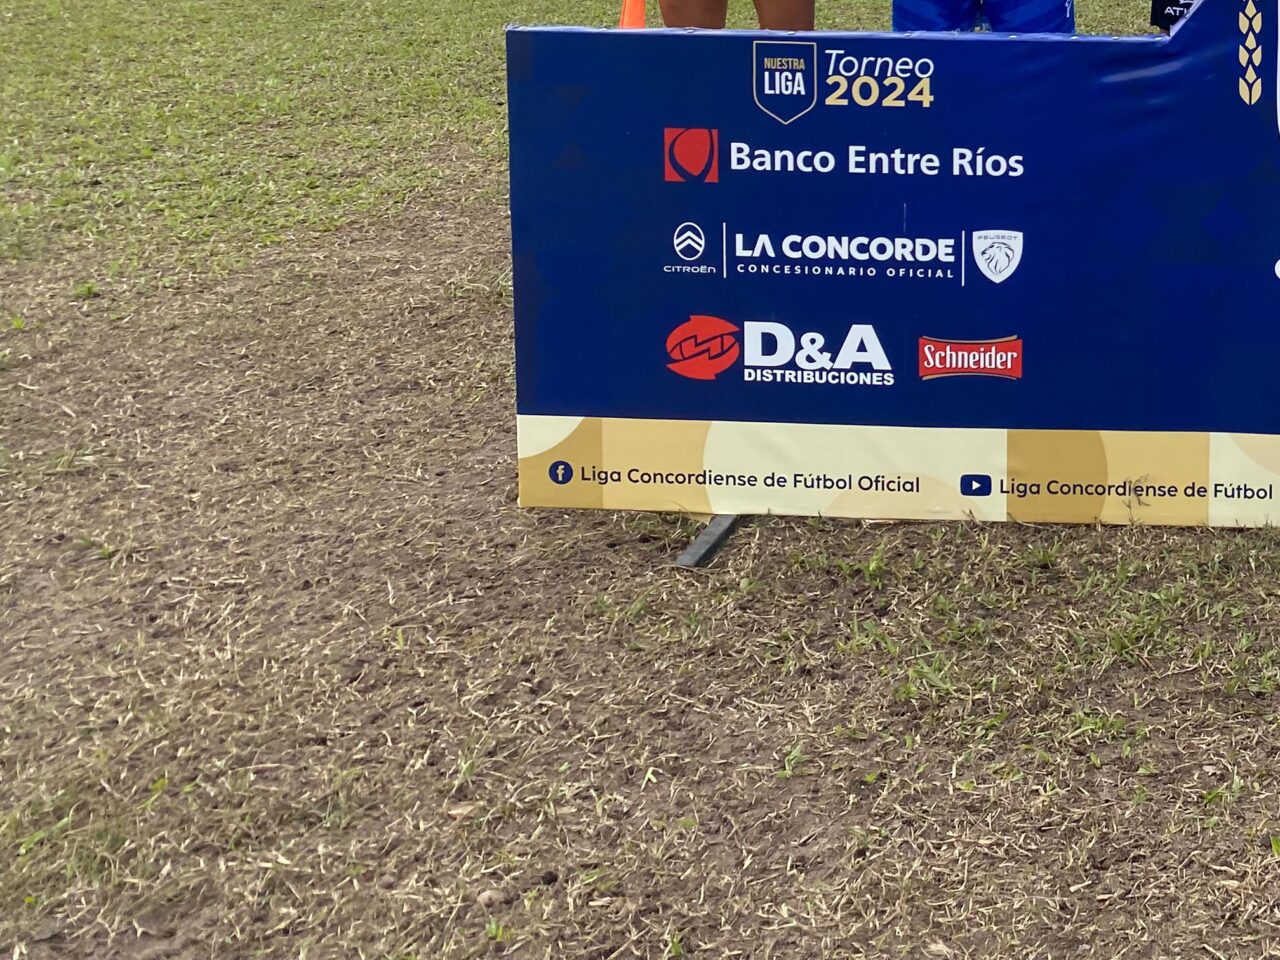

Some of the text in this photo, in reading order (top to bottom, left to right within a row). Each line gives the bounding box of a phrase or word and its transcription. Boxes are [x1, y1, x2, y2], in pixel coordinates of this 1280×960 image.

[764, 57, 805, 71] NUESTRA
[824, 49, 934, 79] Torneo
[764, 71, 805, 96] LIGA
[825, 75, 934, 108] 2024
[730, 142, 1024, 177] Banco Entre Ríos
[735, 233, 955, 263] LA CONCORDE
[737, 263, 954, 279] CONCESIONARIO OFICIAL
[743, 320, 892, 371] D&A
[923, 344, 1018, 371] Schneider
[744, 369, 895, 386] DISTRIBUCIONES
[580, 466, 920, 493] Liga Concordiense de Fútbol Oficial
[1000, 478, 1273, 500] Liga Concordiense de Fútbol
